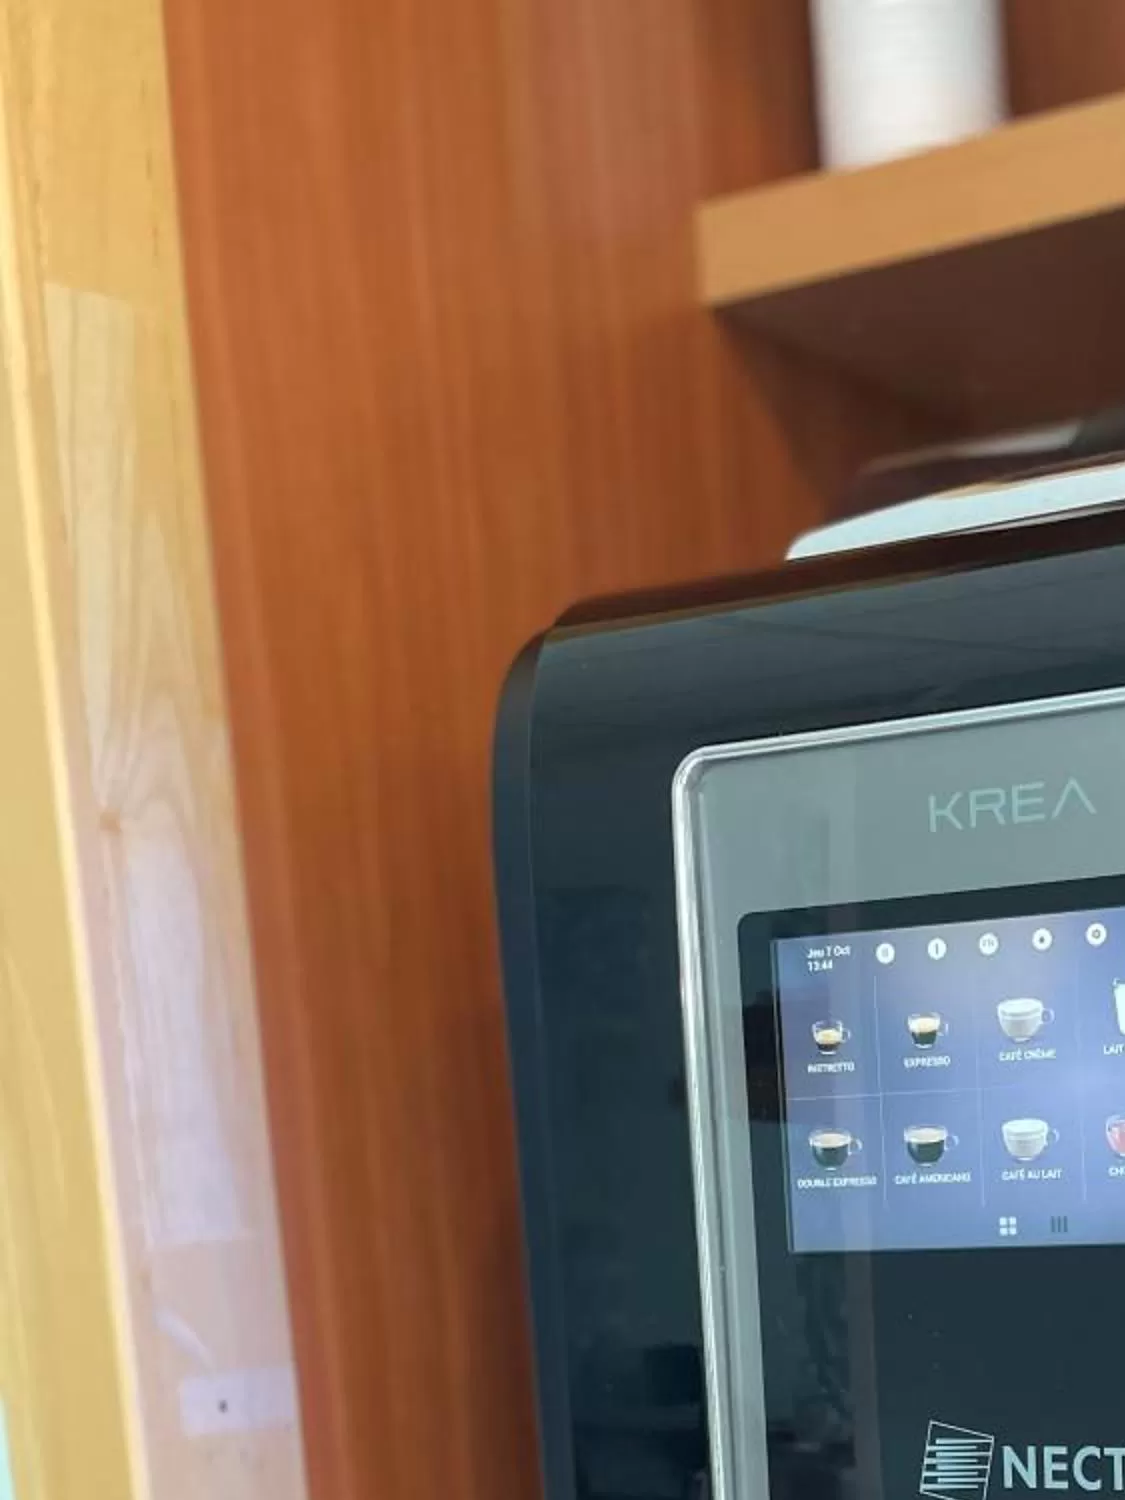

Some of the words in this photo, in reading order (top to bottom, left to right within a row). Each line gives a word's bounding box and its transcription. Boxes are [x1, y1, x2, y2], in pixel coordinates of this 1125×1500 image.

[928, 776, 1098, 833] KREA
[1103, 1043, 1124, 1056] LAIT
[1027, 1168, 1041, 1180] AU
[1041, 1167, 1063, 1180] LAIT
